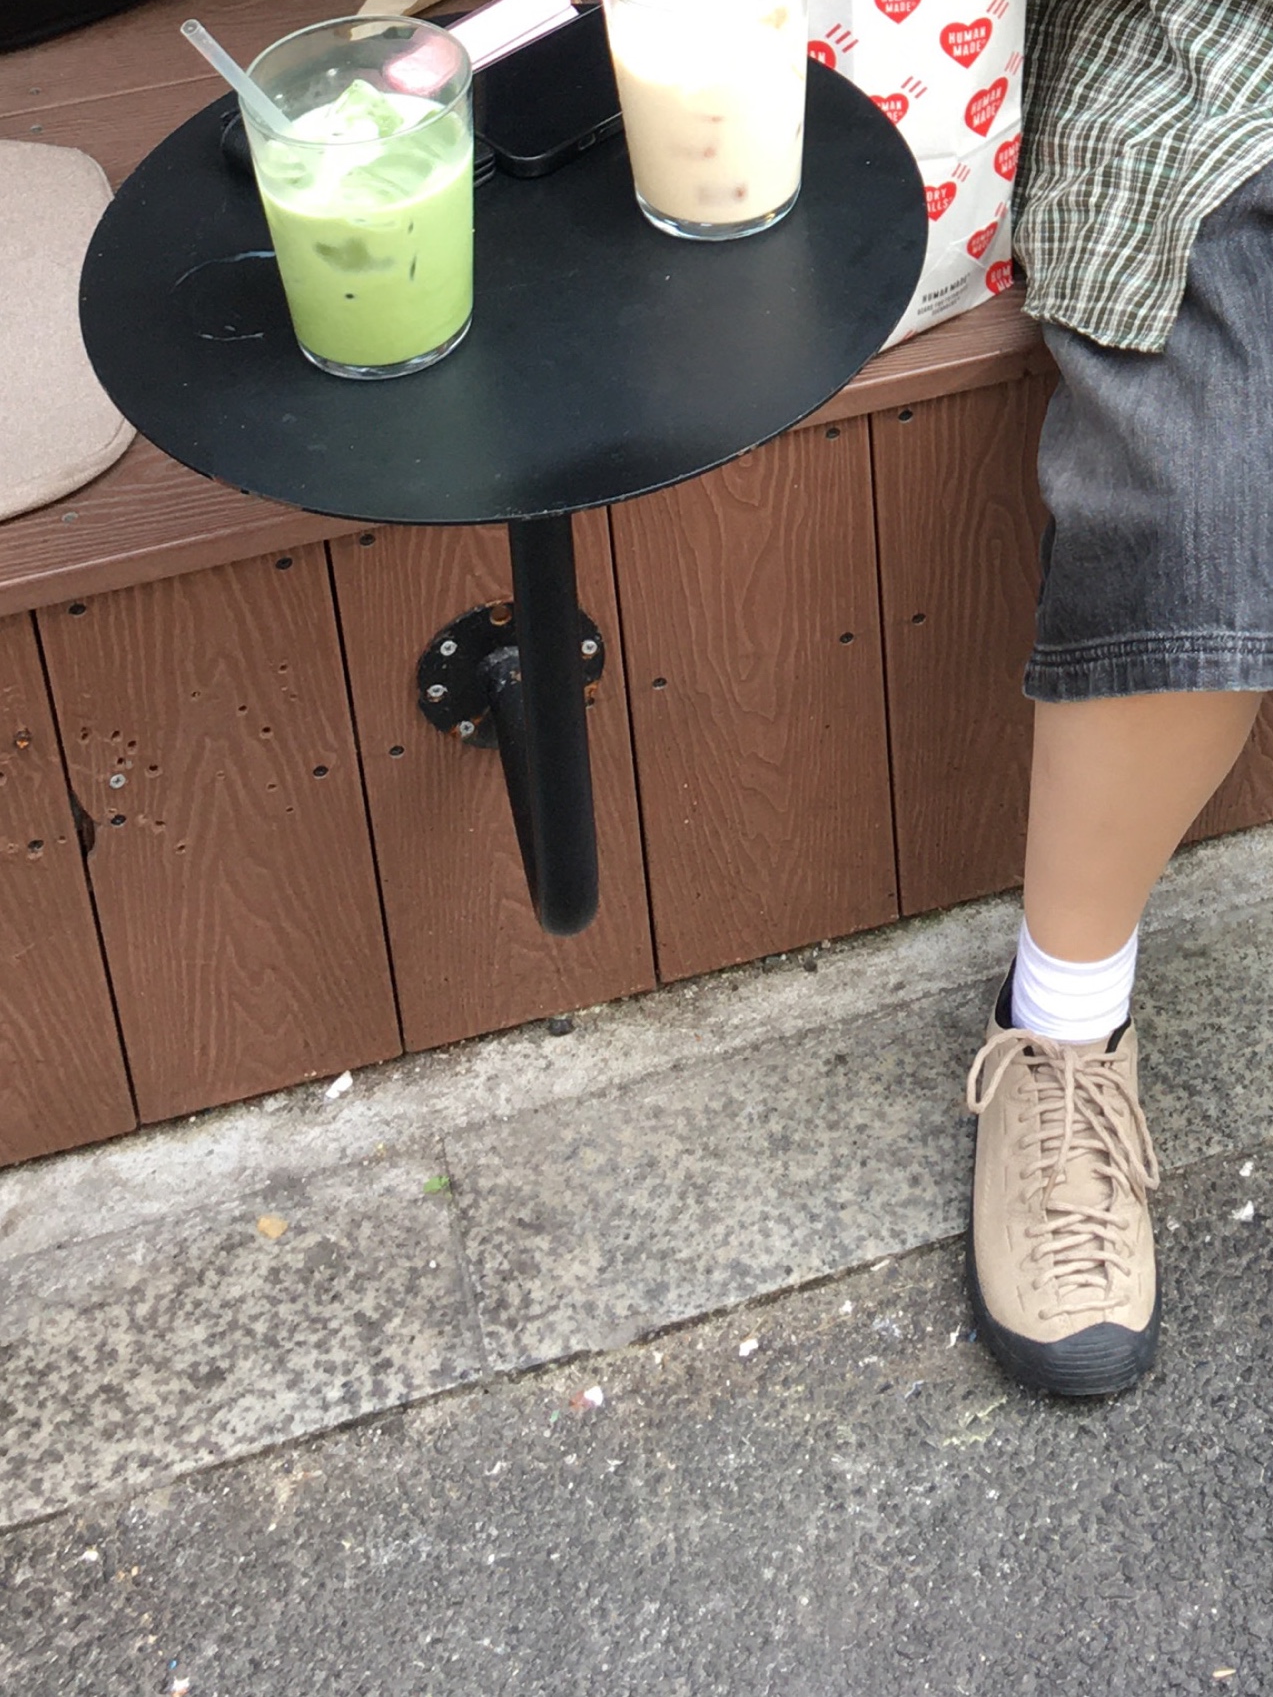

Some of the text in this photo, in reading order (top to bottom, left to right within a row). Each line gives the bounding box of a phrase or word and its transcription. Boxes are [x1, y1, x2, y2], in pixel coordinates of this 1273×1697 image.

[947, 26, 987, 45] HUMAN
[877, 99, 902, 112] MAN
[970, 86, 1002, 116] HUMAN
[926, 187, 948, 202] DRY
